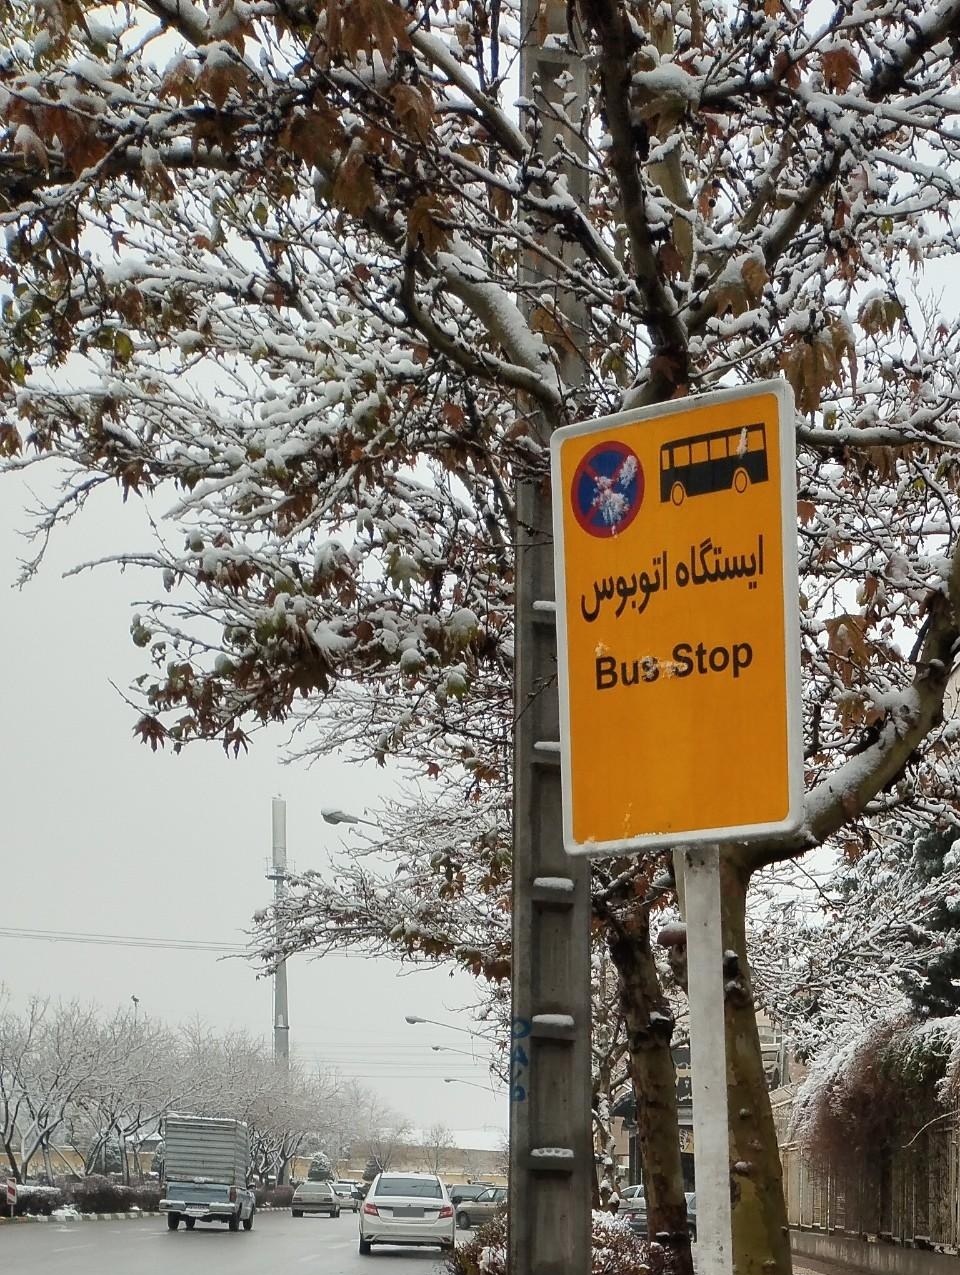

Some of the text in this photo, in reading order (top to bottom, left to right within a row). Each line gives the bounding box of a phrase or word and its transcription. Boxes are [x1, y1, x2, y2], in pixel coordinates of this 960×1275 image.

[580, 534, 764, 623] ایستگاه اتوبوس
[595, 641, 753, 690] Bus Stop
